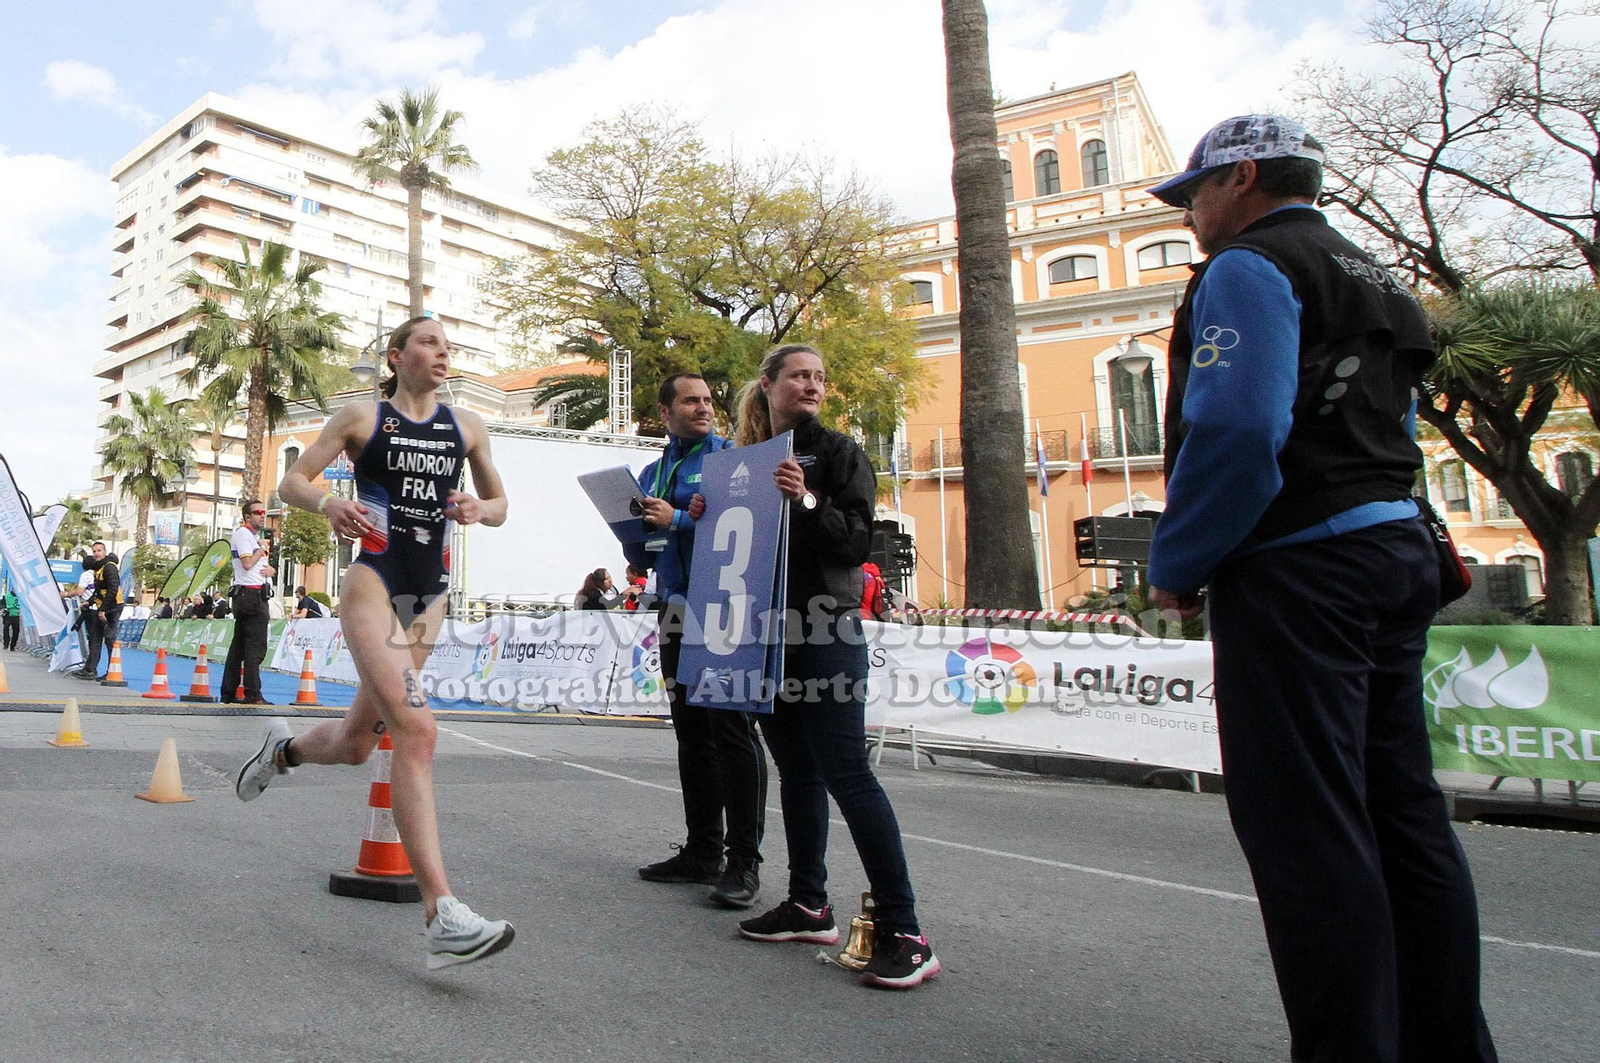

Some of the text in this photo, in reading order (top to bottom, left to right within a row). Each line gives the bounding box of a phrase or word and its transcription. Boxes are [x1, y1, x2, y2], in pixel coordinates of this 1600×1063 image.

[387, 451, 457, 477] LANDRON
[402, 477, 438, 501] FRA
[390, 504, 429, 517] VINCI
[704, 506, 754, 656] 3
[1053, 661, 1217, 707] LaLiga4
[1095, 709, 1121, 721] con
[1124, 711, 1137, 723] el
[1141, 712, 1198, 732] Deporte
[1202, 721, 1219, 735] Es
